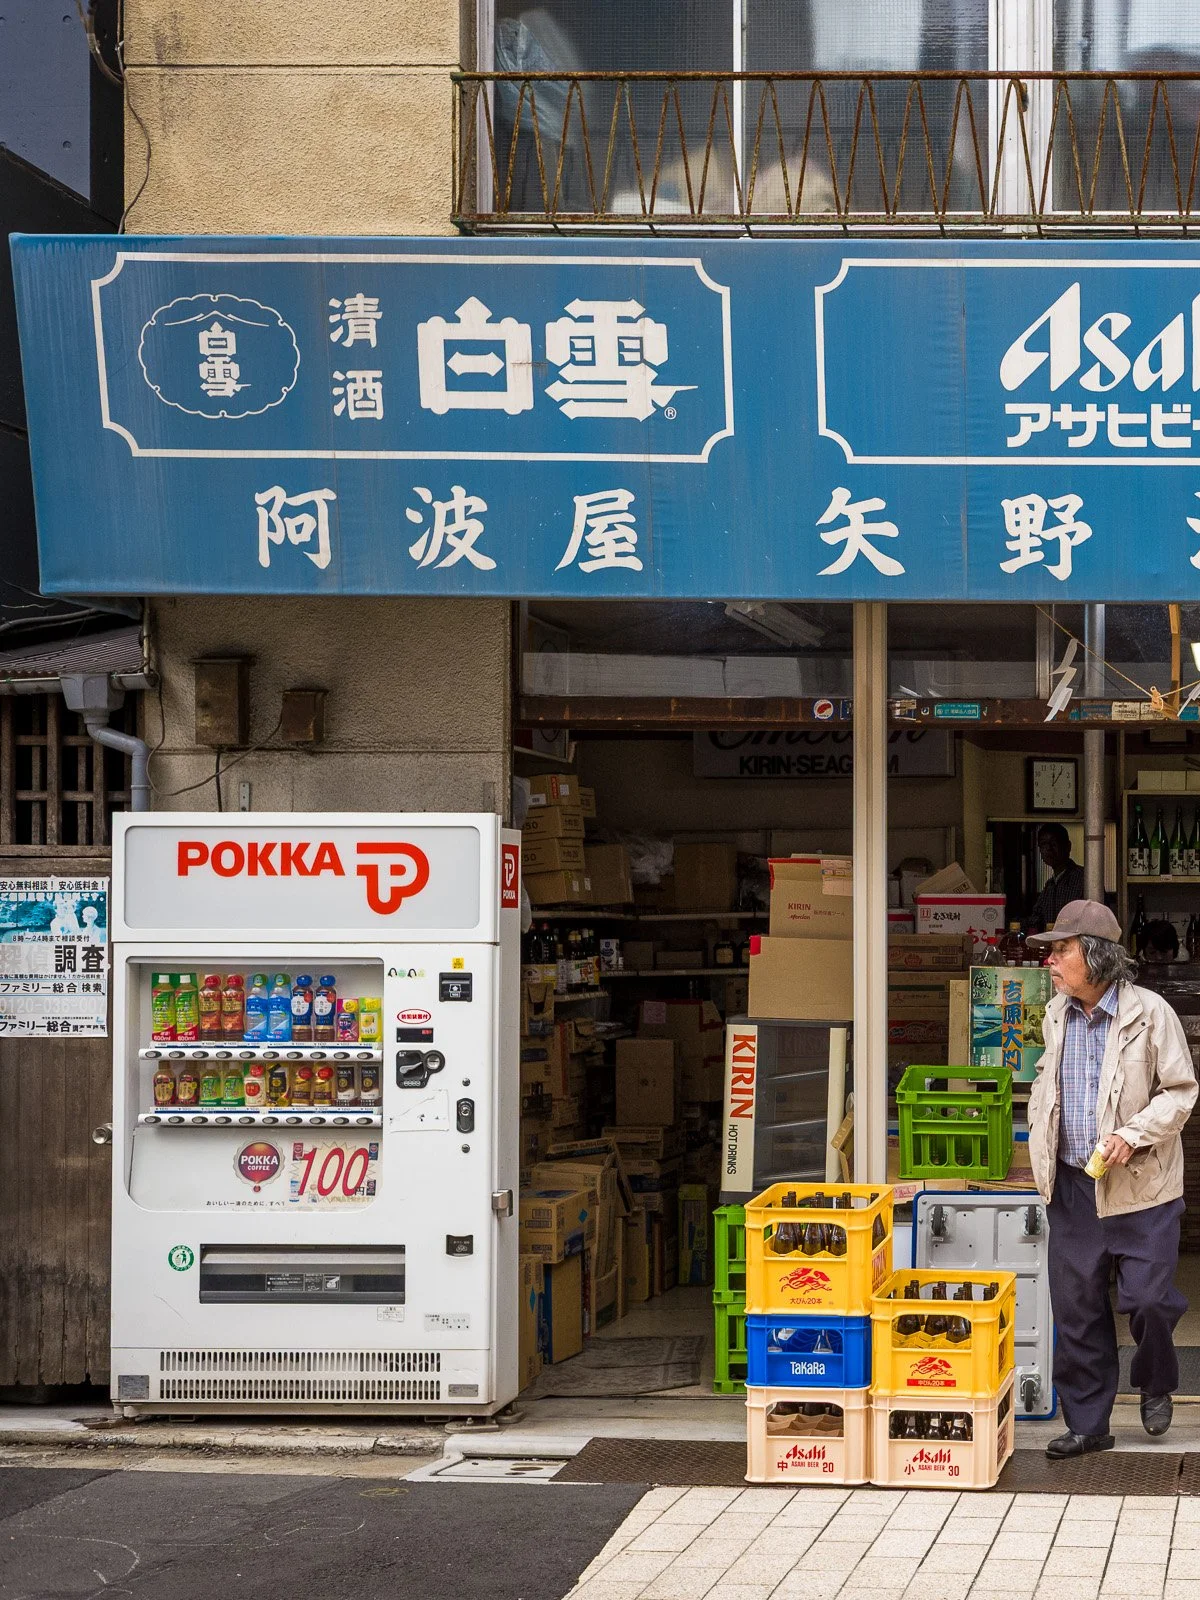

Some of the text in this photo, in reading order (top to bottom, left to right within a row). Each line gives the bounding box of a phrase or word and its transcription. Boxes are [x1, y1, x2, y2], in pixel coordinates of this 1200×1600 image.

[199, 321, 251, 397] 白雪
[328, 293, 383, 420] 清酒
[417, 296, 698, 422] 白雪
[254, 485, 644, 572] 阿波屋
[177, 841, 345, 877] POKKA
[788, 903, 811, 911] KIRIN
[82, 982, 102, 993] 検索
[730, 1033, 757, 1119] KIRIN
[726, 1123, 739, 1175] HOT DRINKS
[240, 1155, 279, 1165] POKKA
[789, 1297, 823, 1305] 大びん20本
[785, 1444, 827, 1460] Asahi
[912, 1448, 951, 1464] Asahi
[777, 1460, 788, 1472] 中
[822, 1462, 834, 1473] 20
[904, 1463, 960, 1477] 小 ASAHI BEER 30
